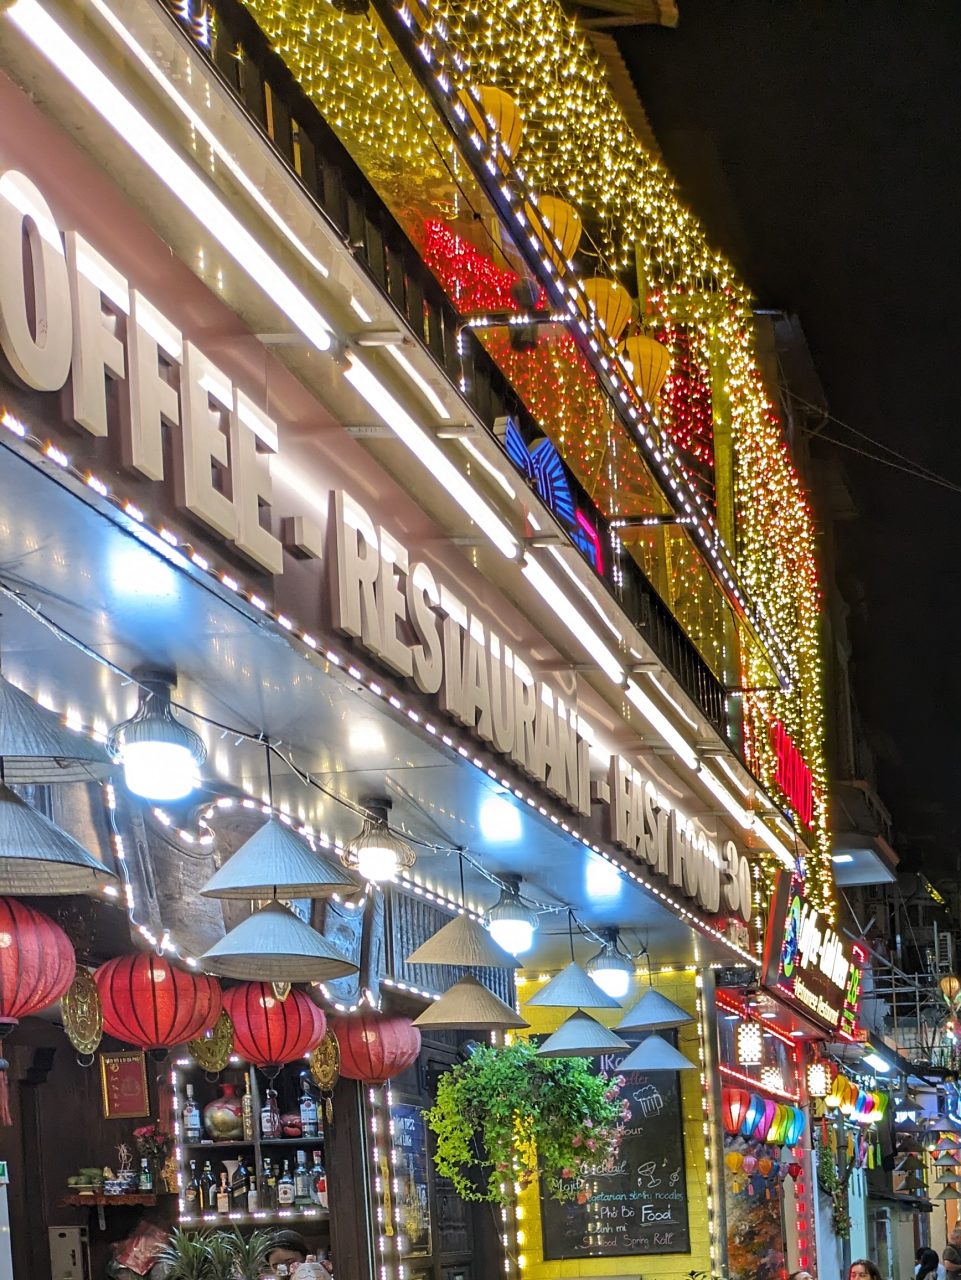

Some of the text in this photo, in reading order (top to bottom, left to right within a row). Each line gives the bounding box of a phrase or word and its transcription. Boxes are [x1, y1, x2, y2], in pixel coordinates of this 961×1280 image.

[332, 489, 592, 817] RESTAURANT
[610, 754, 672, 876] FAST
[641, 1203, 672, 1223] Food
